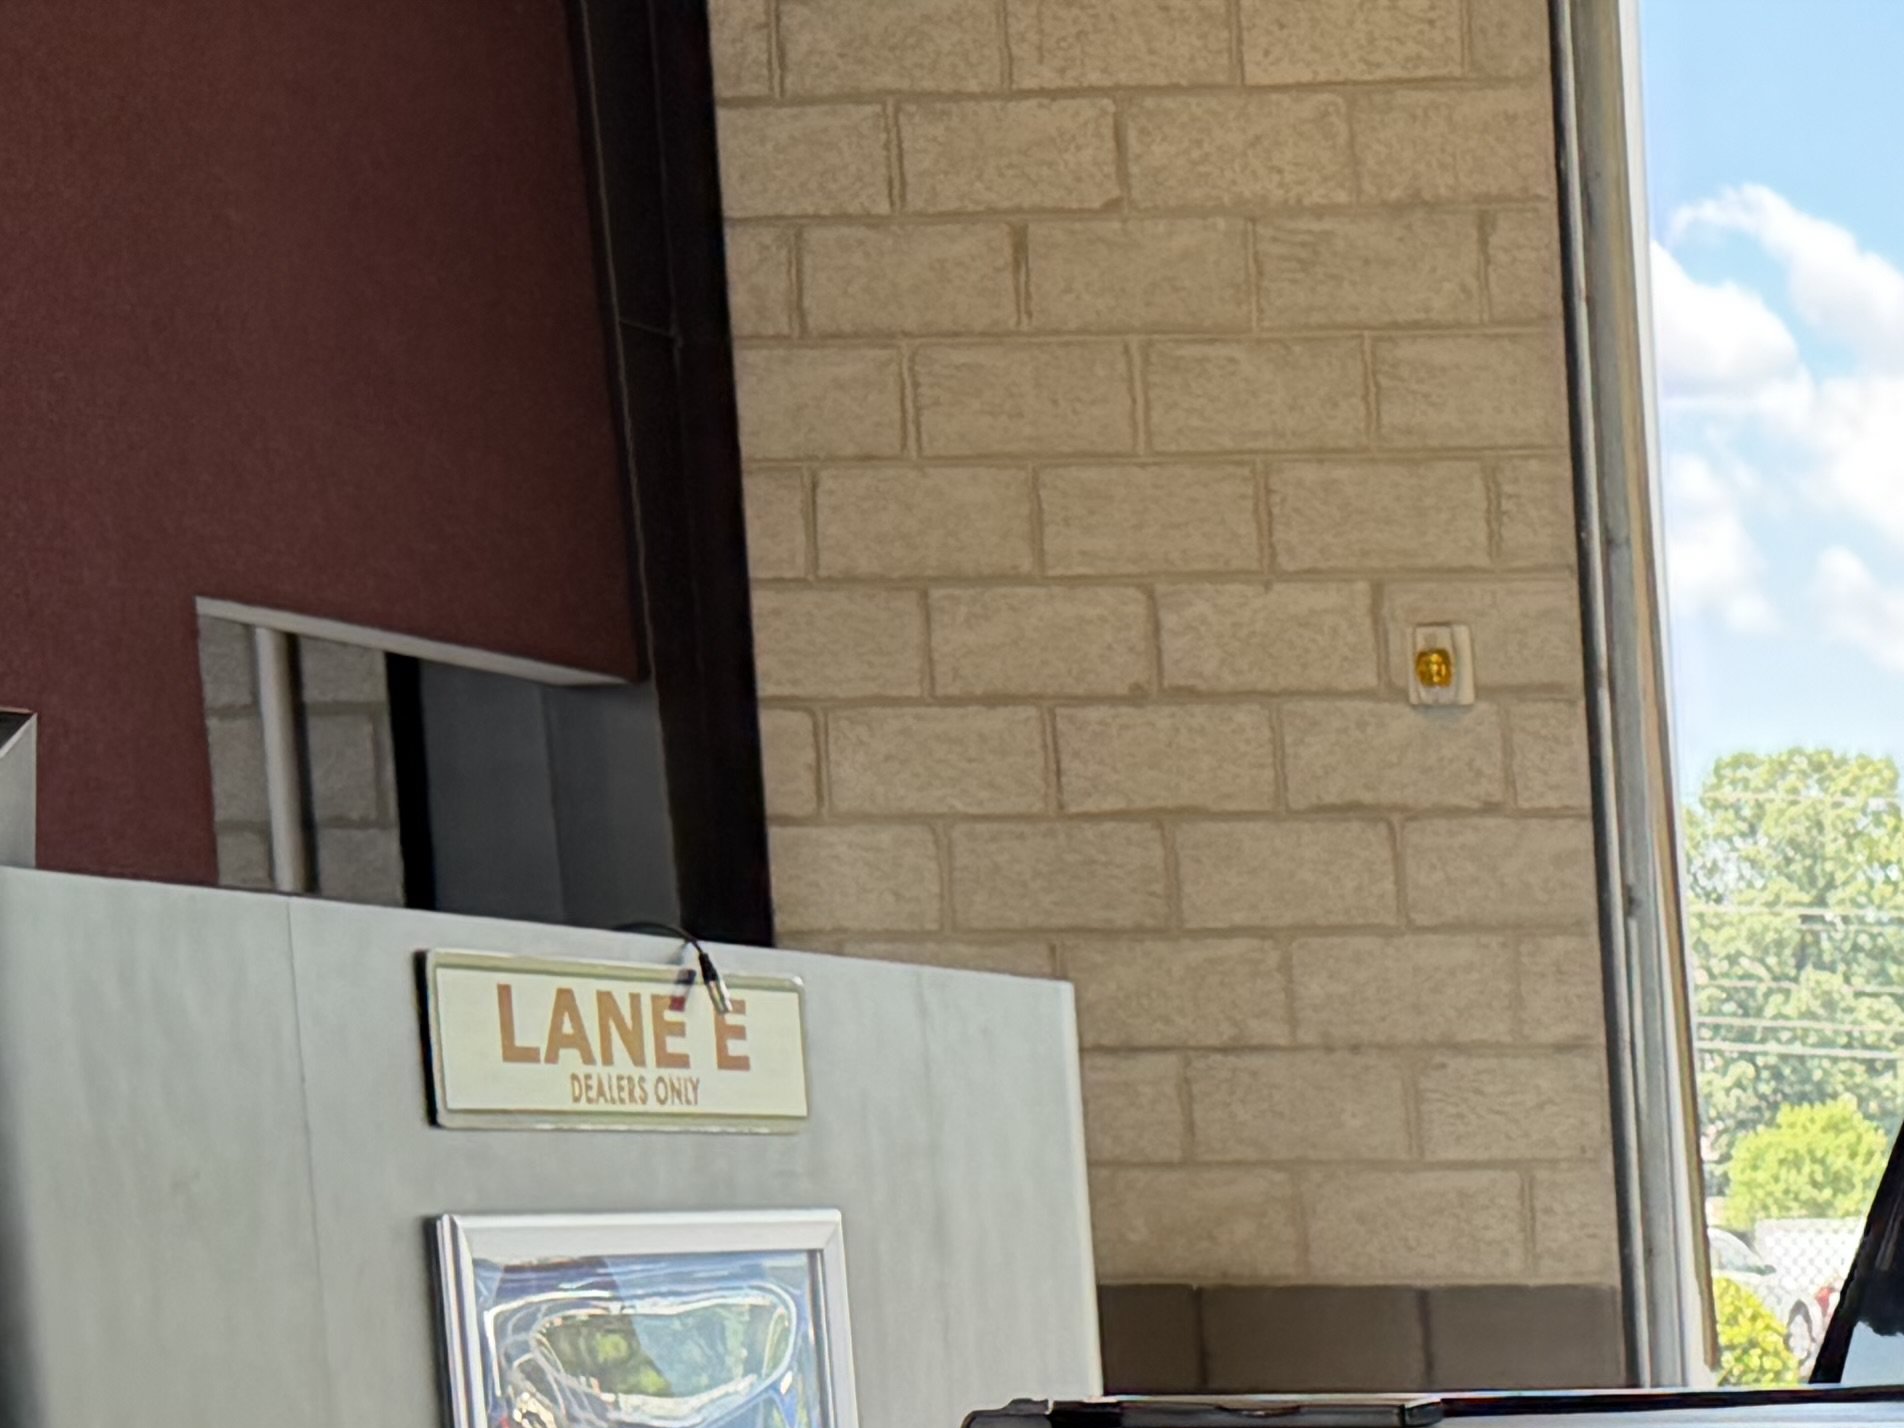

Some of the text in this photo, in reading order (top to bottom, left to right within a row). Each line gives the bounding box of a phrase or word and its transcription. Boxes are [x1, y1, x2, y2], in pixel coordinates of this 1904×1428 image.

[497, 983, 752, 1072] LANE E
[570, 1072, 701, 1107] DEALERS ONLY
